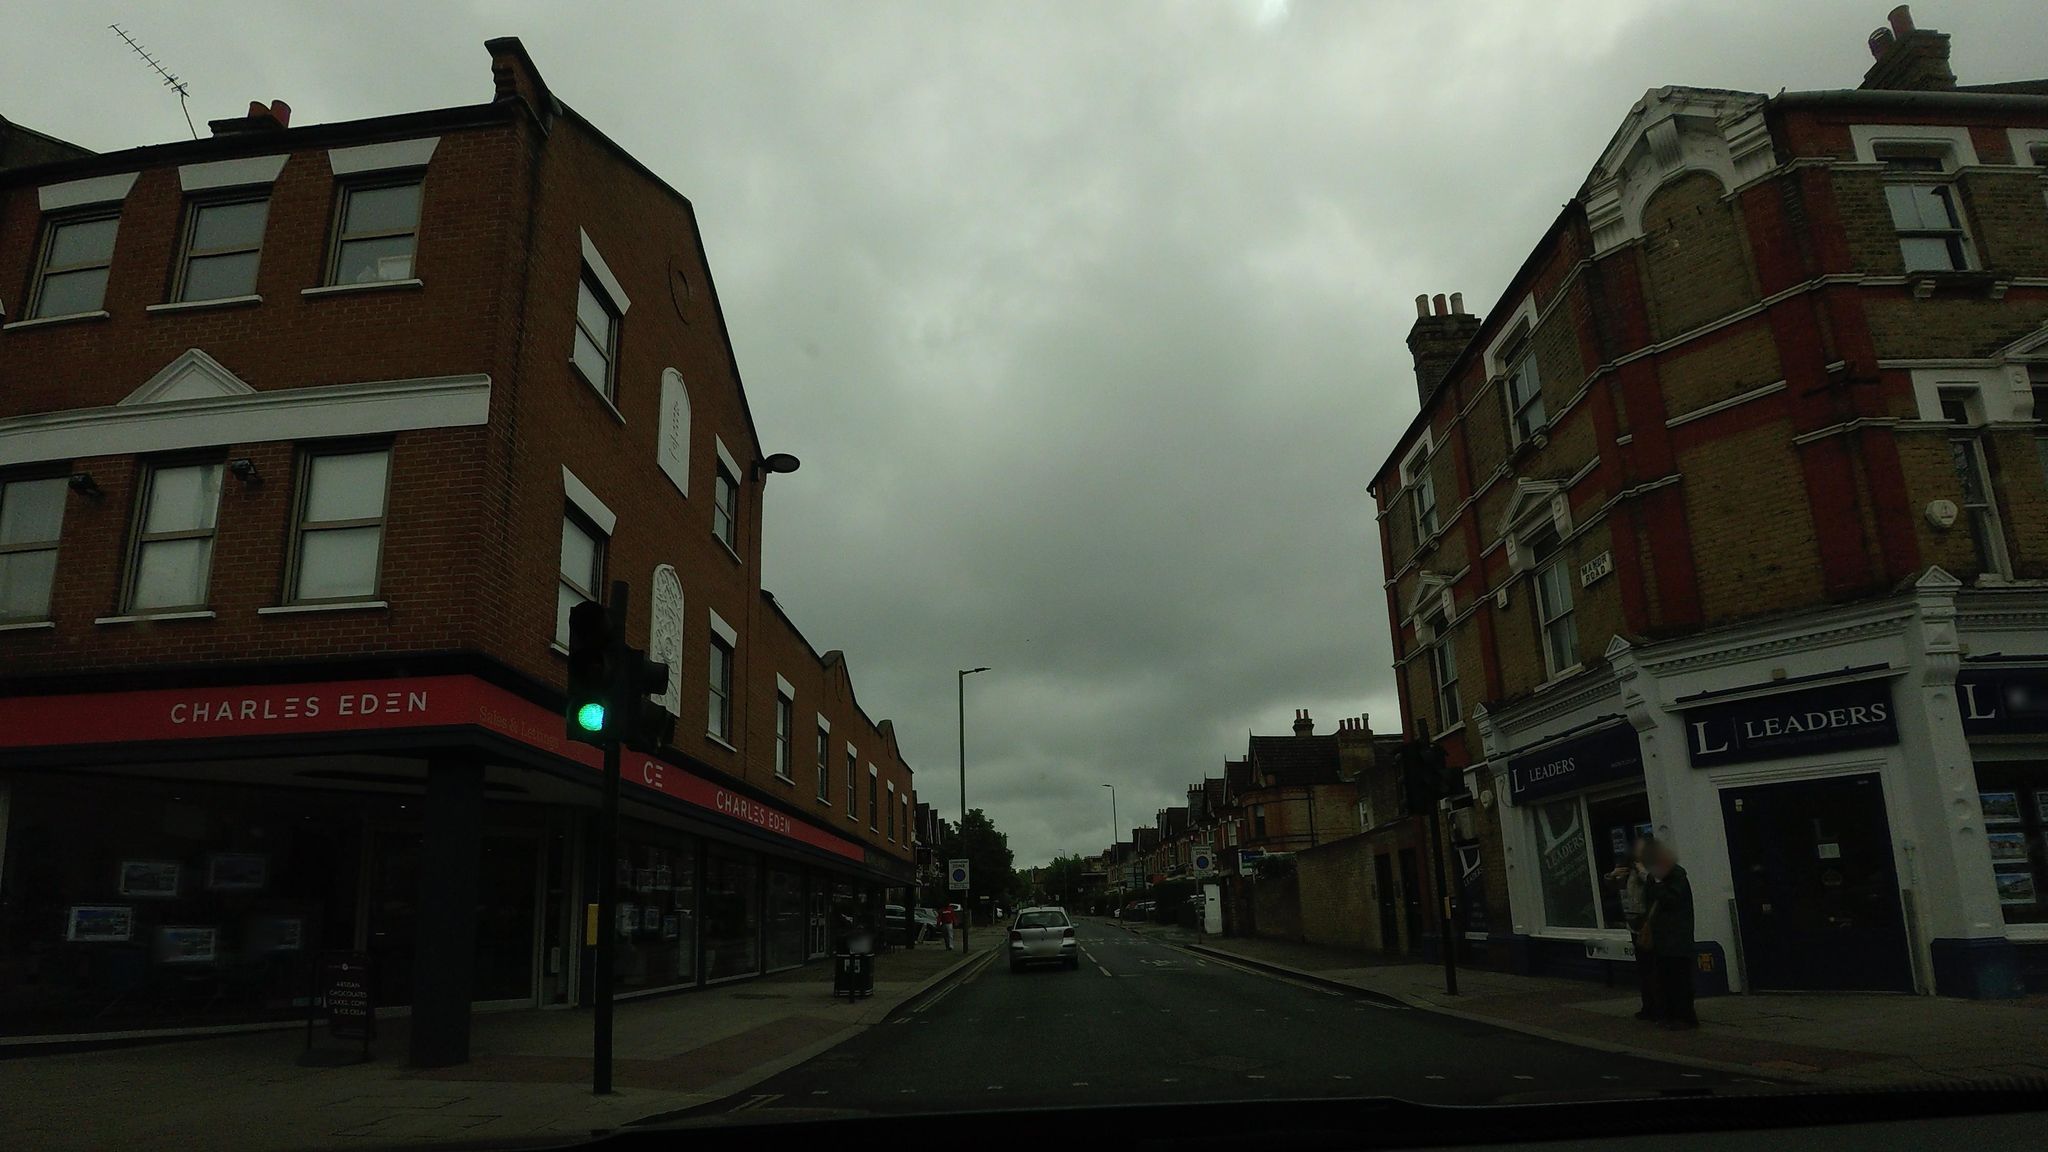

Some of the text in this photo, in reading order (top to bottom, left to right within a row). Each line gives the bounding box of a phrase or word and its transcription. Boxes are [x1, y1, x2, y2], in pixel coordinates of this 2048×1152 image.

[1582, 554, 1607, 576] MANOR
[1585, 565, 1606, 584] ROAD
[170, 691, 428, 724] CHARLES EDEN
[1960, 683, 1996, 719] L
[479, 705, 508, 728] Sales
[509, 717, 518, 734] &
[1691, 720, 1729, 756] L
[1744, 702, 1887, 740] LEADERS
[643, 760, 664, 788] CE
[1512, 756, 1576, 793] L LEADERS
[716, 790, 791, 833] CHARLES EDEN
[1545, 832, 1585, 870] LEADERS
